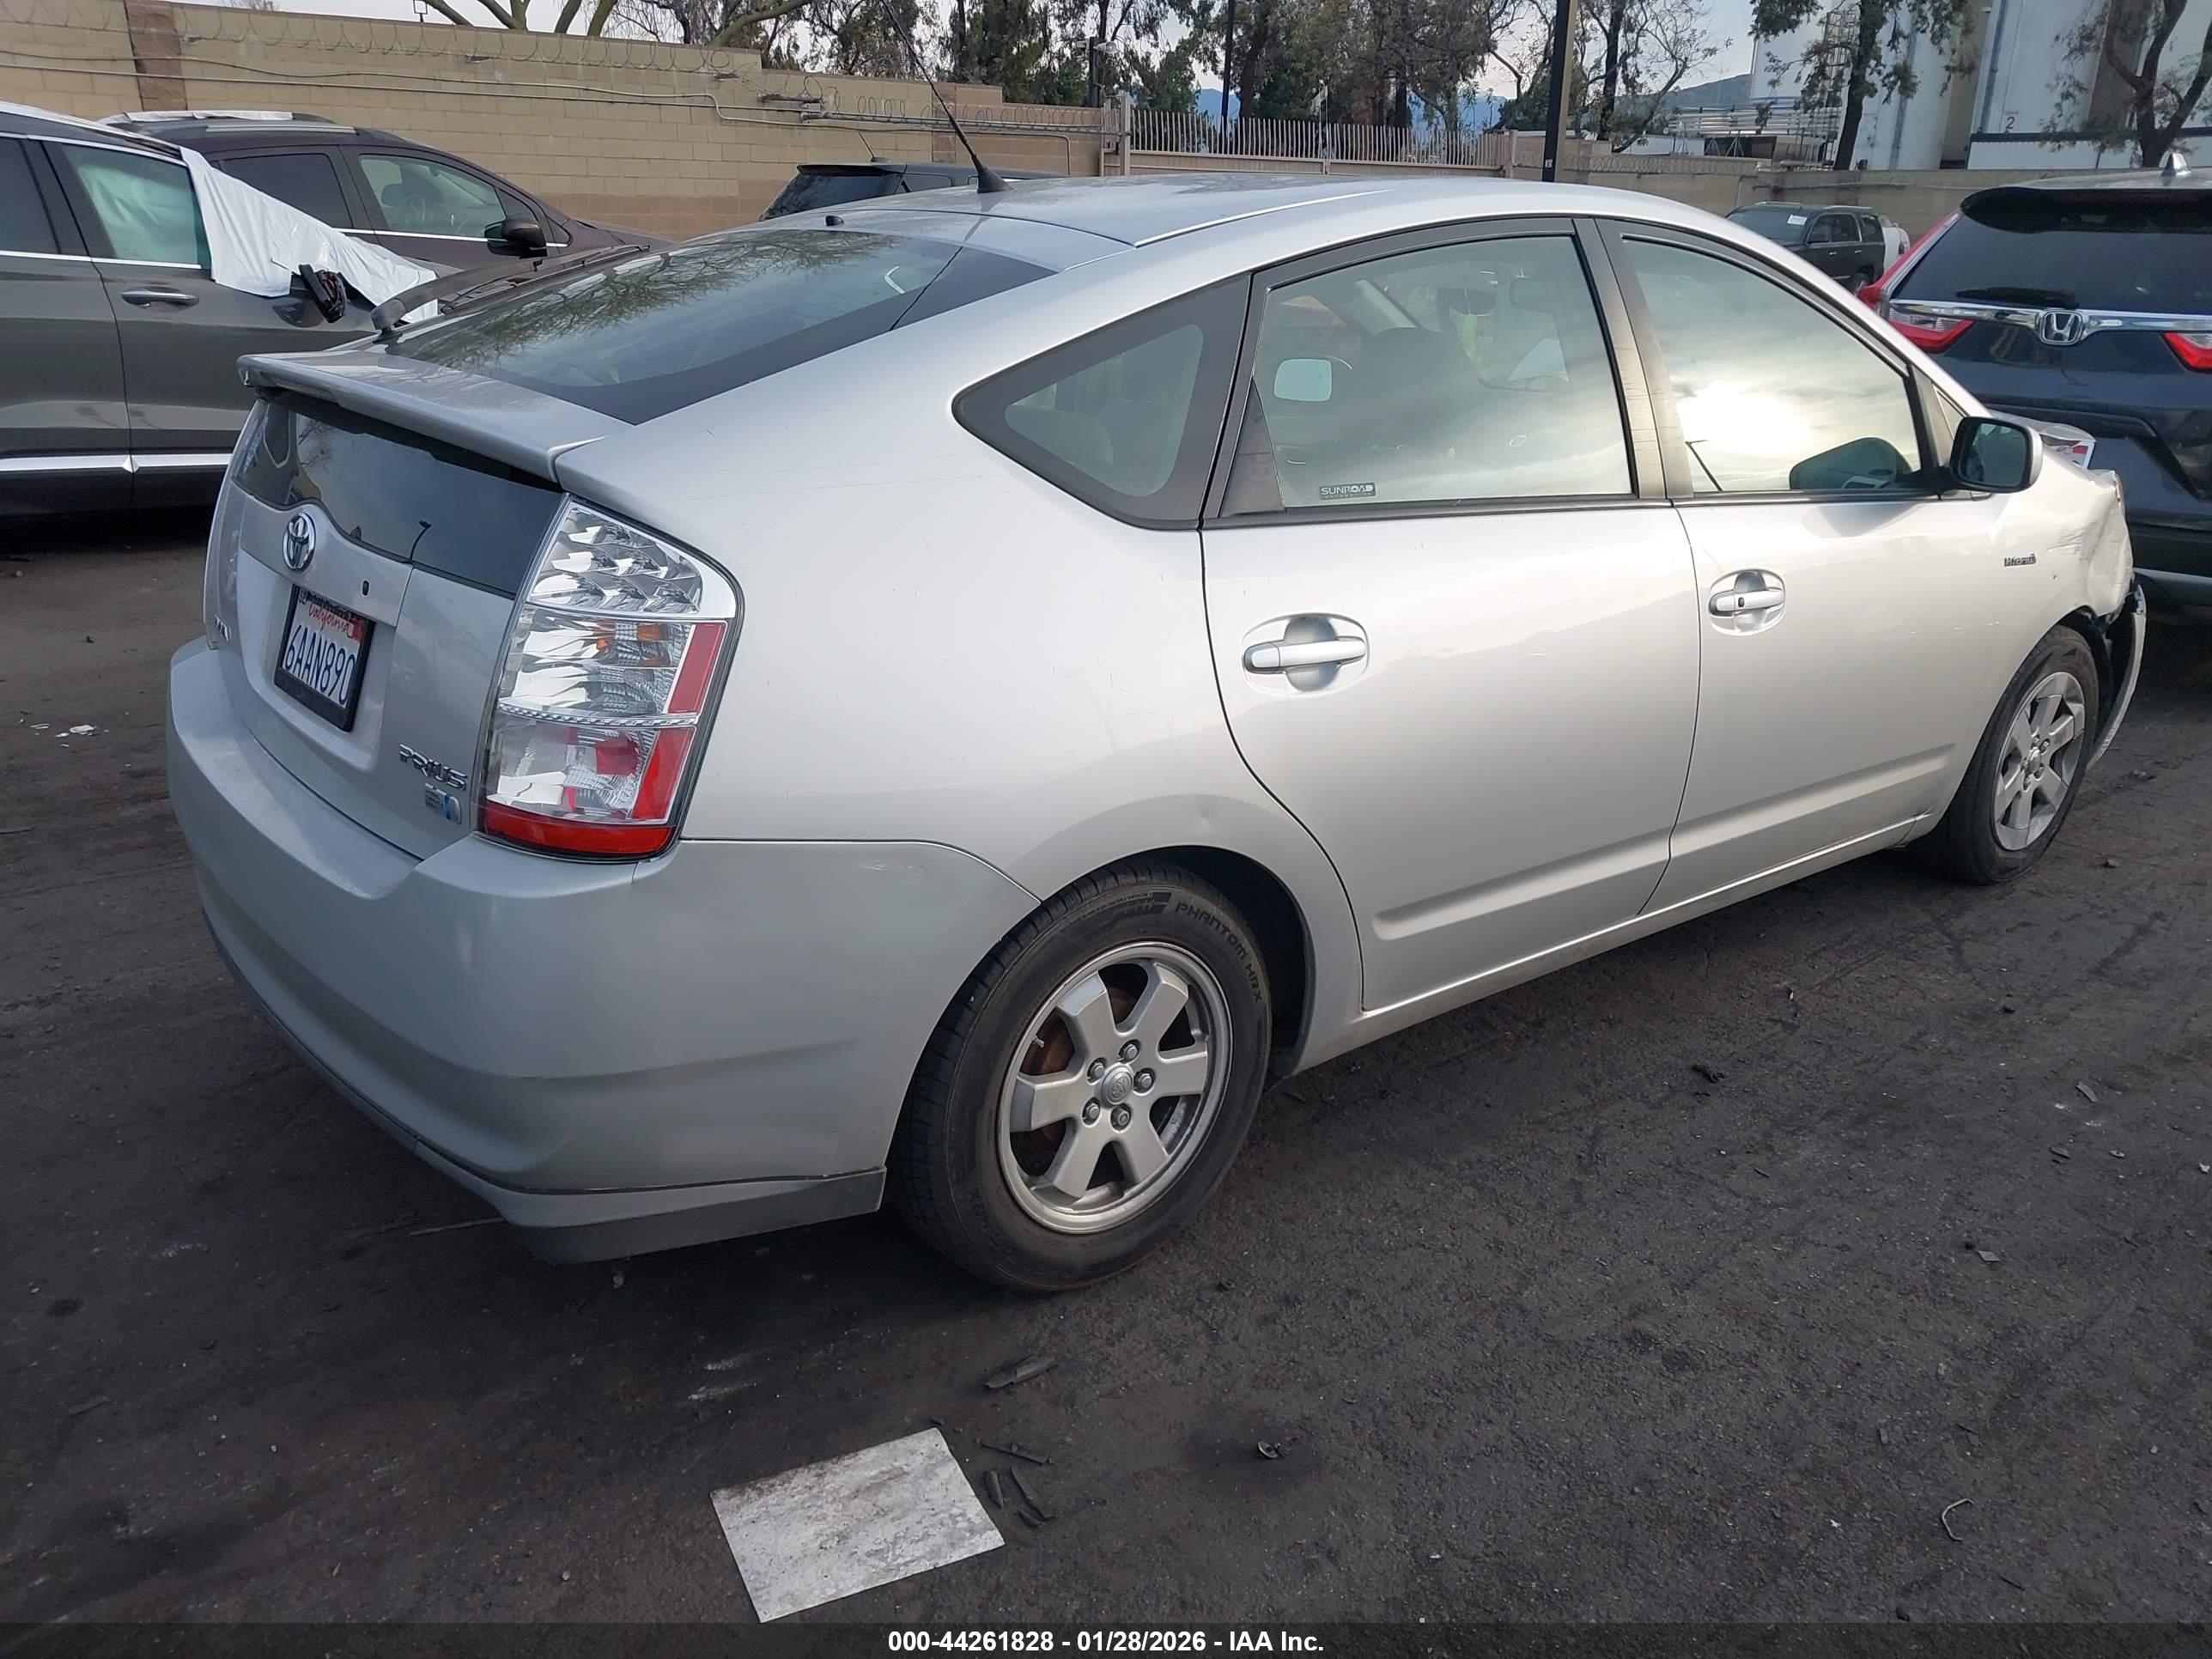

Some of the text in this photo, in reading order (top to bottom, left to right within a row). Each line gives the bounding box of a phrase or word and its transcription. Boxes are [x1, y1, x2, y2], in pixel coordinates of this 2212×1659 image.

[2006, 116, 2015, 130] 2
[1321, 484, 1374, 495] SUNROAD
[284, 623, 356, 705] 6AAN890
[399, 743, 468, 791] PRIUS
[1175, 902, 1263, 1004] PHANTOM HRX
